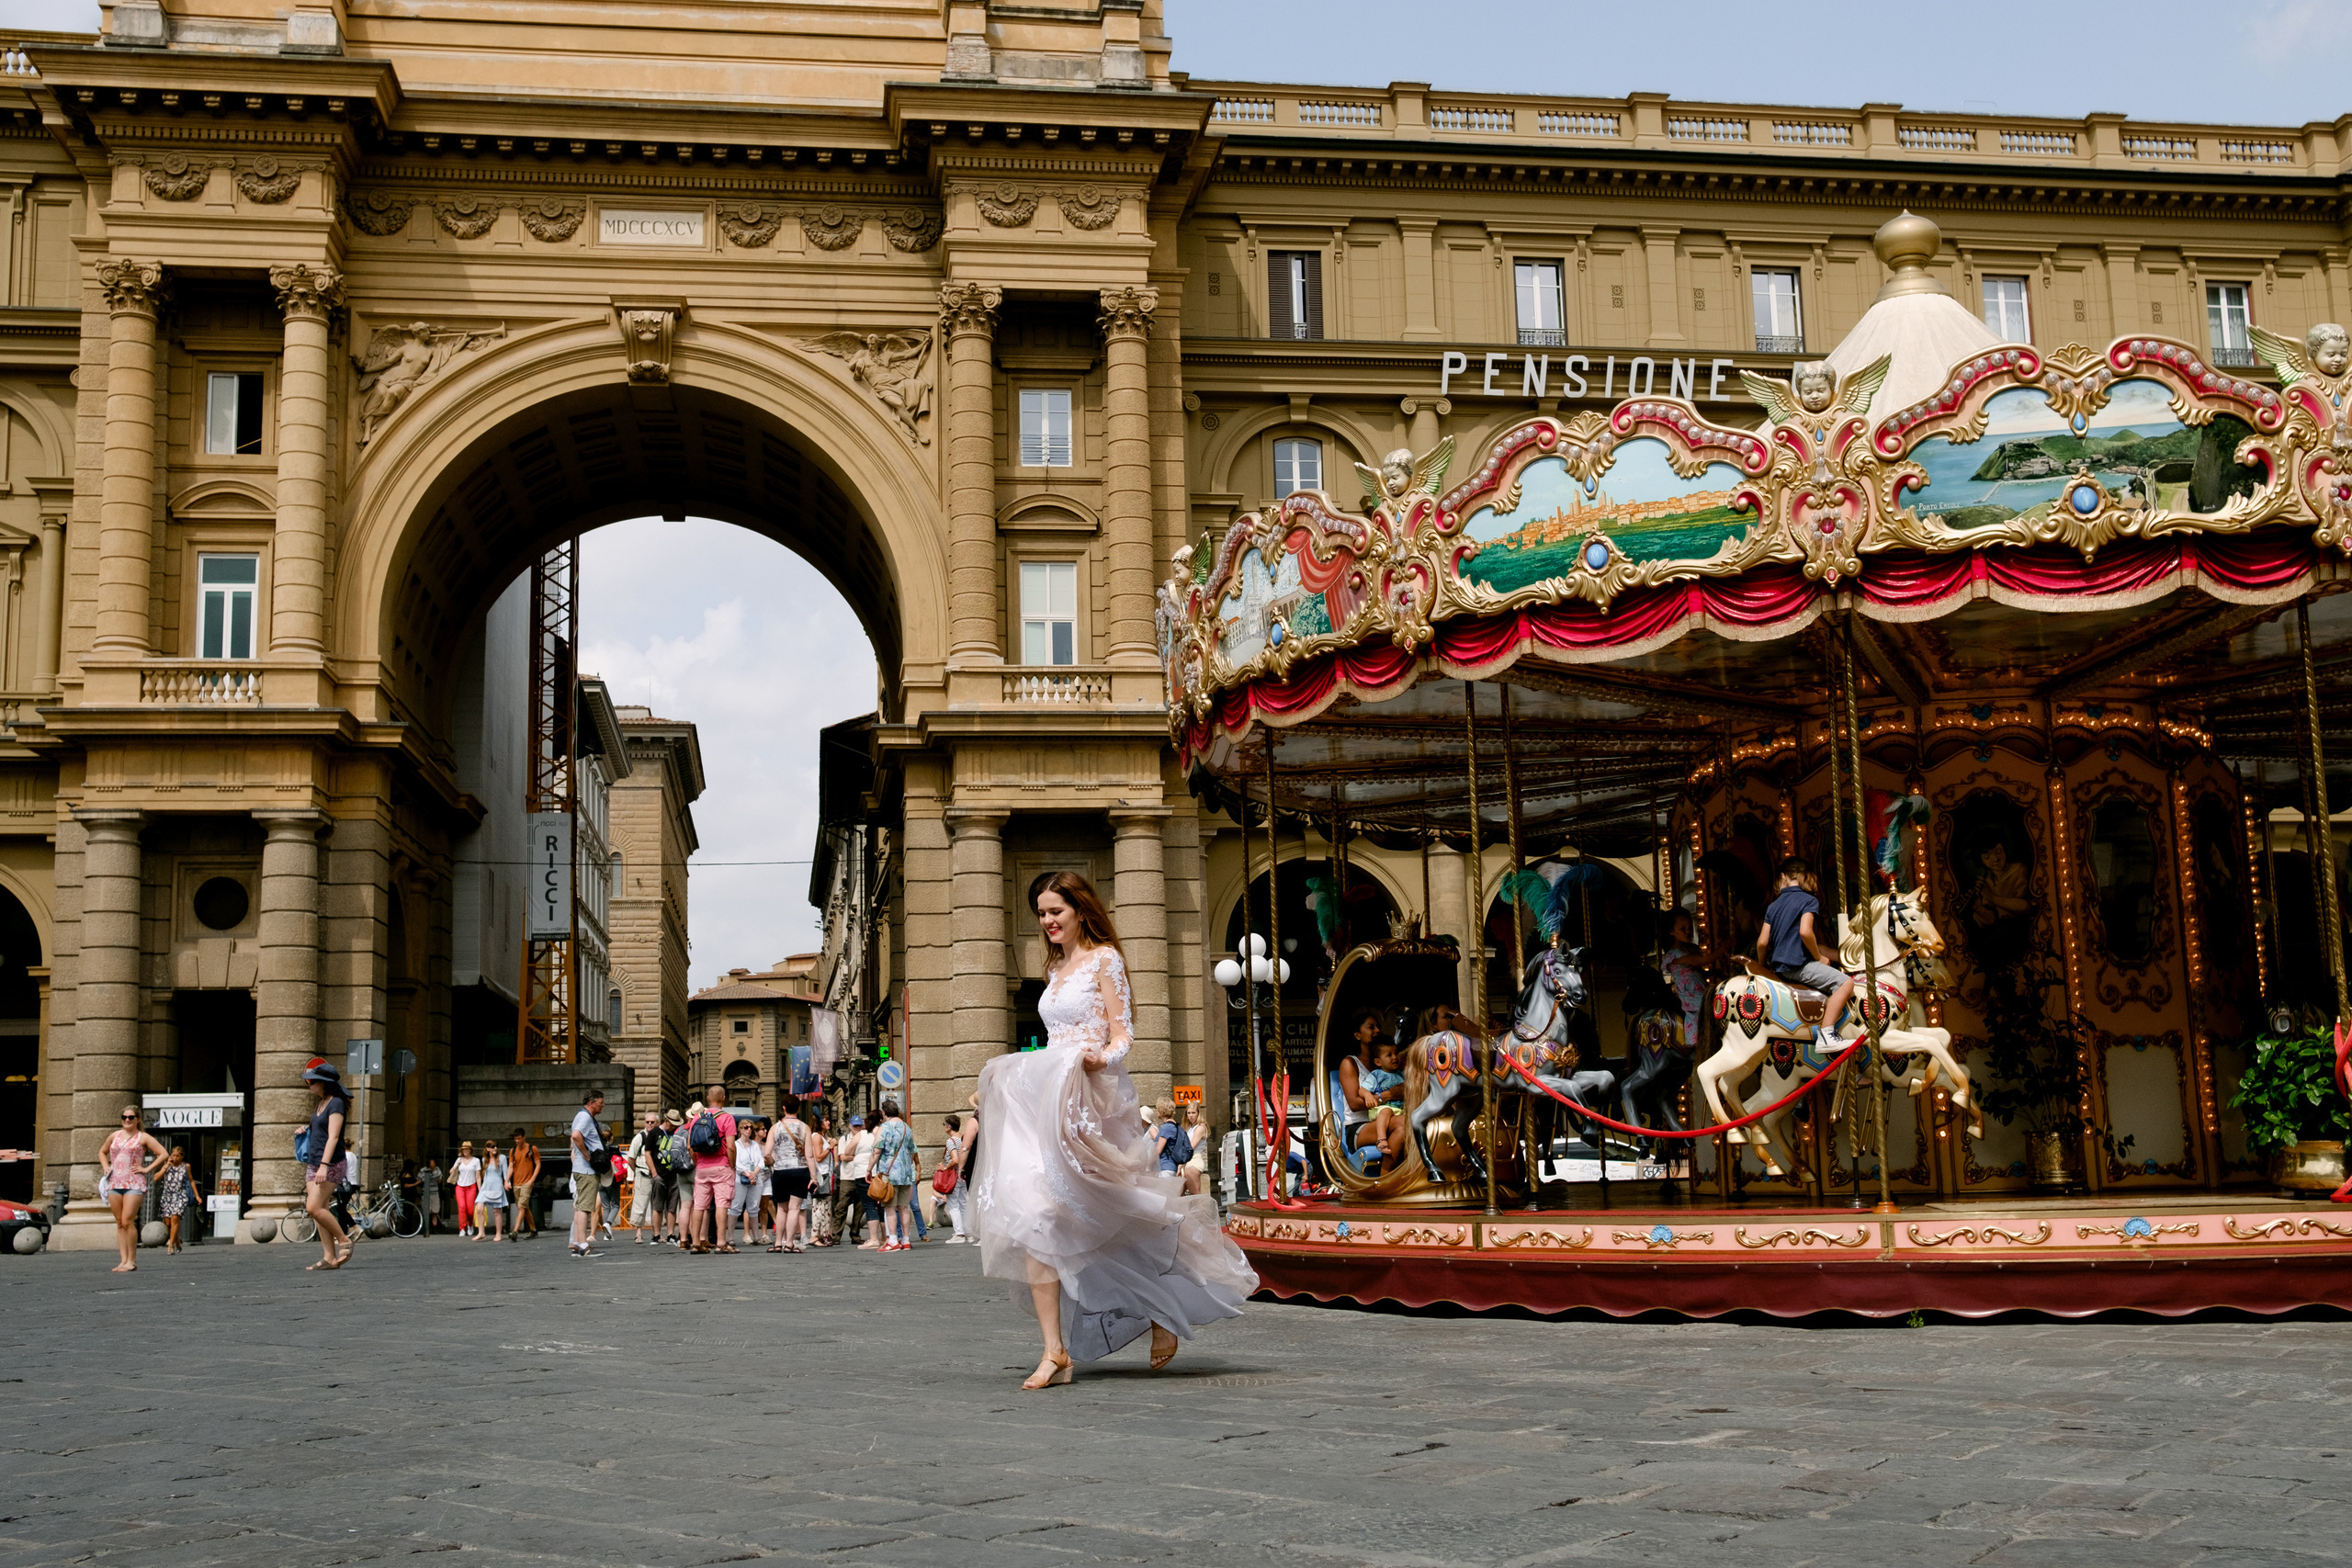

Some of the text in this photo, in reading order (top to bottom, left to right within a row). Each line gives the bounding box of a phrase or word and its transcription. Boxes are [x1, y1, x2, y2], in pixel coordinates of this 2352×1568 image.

[605, 220, 697, 236] MDCCCXCV
[1441, 351, 1734, 401] PENSIONE
[545, 835, 559, 921] RICCI
[1229, 1023, 1315, 1036] TAACHI
[1284, 1038, 1317, 1046] ARTICOL
[1283, 1047, 1314, 1055] FUMATO
[1176, 1090, 1201, 1100] TAXI
[163, 1110, 221, 1125] VOGUE
